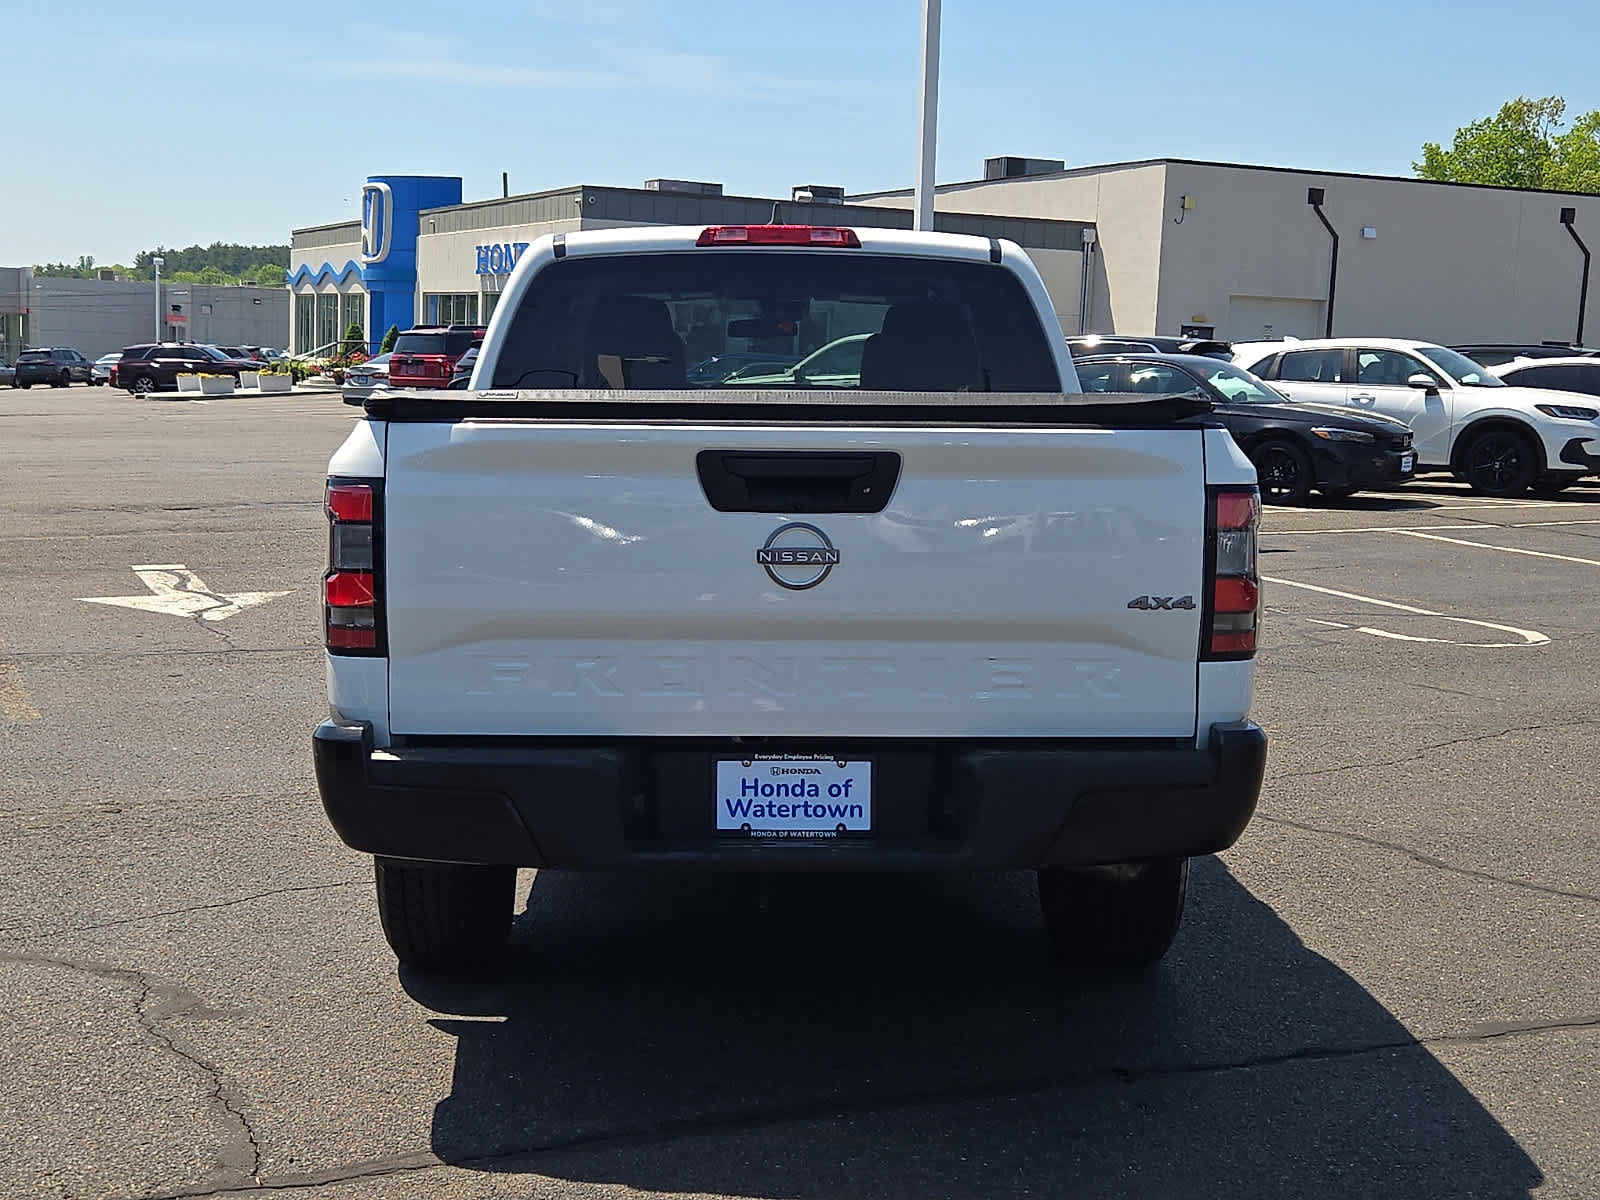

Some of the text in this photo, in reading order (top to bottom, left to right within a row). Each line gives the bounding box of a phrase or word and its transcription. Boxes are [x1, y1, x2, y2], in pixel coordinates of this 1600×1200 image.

[759, 551, 837, 562] NISSAN
[754, 753, 834, 761] Everyday Employee Pricing
[741, 778, 853, 798] Honda of
[725, 798, 863, 818] Watertown
